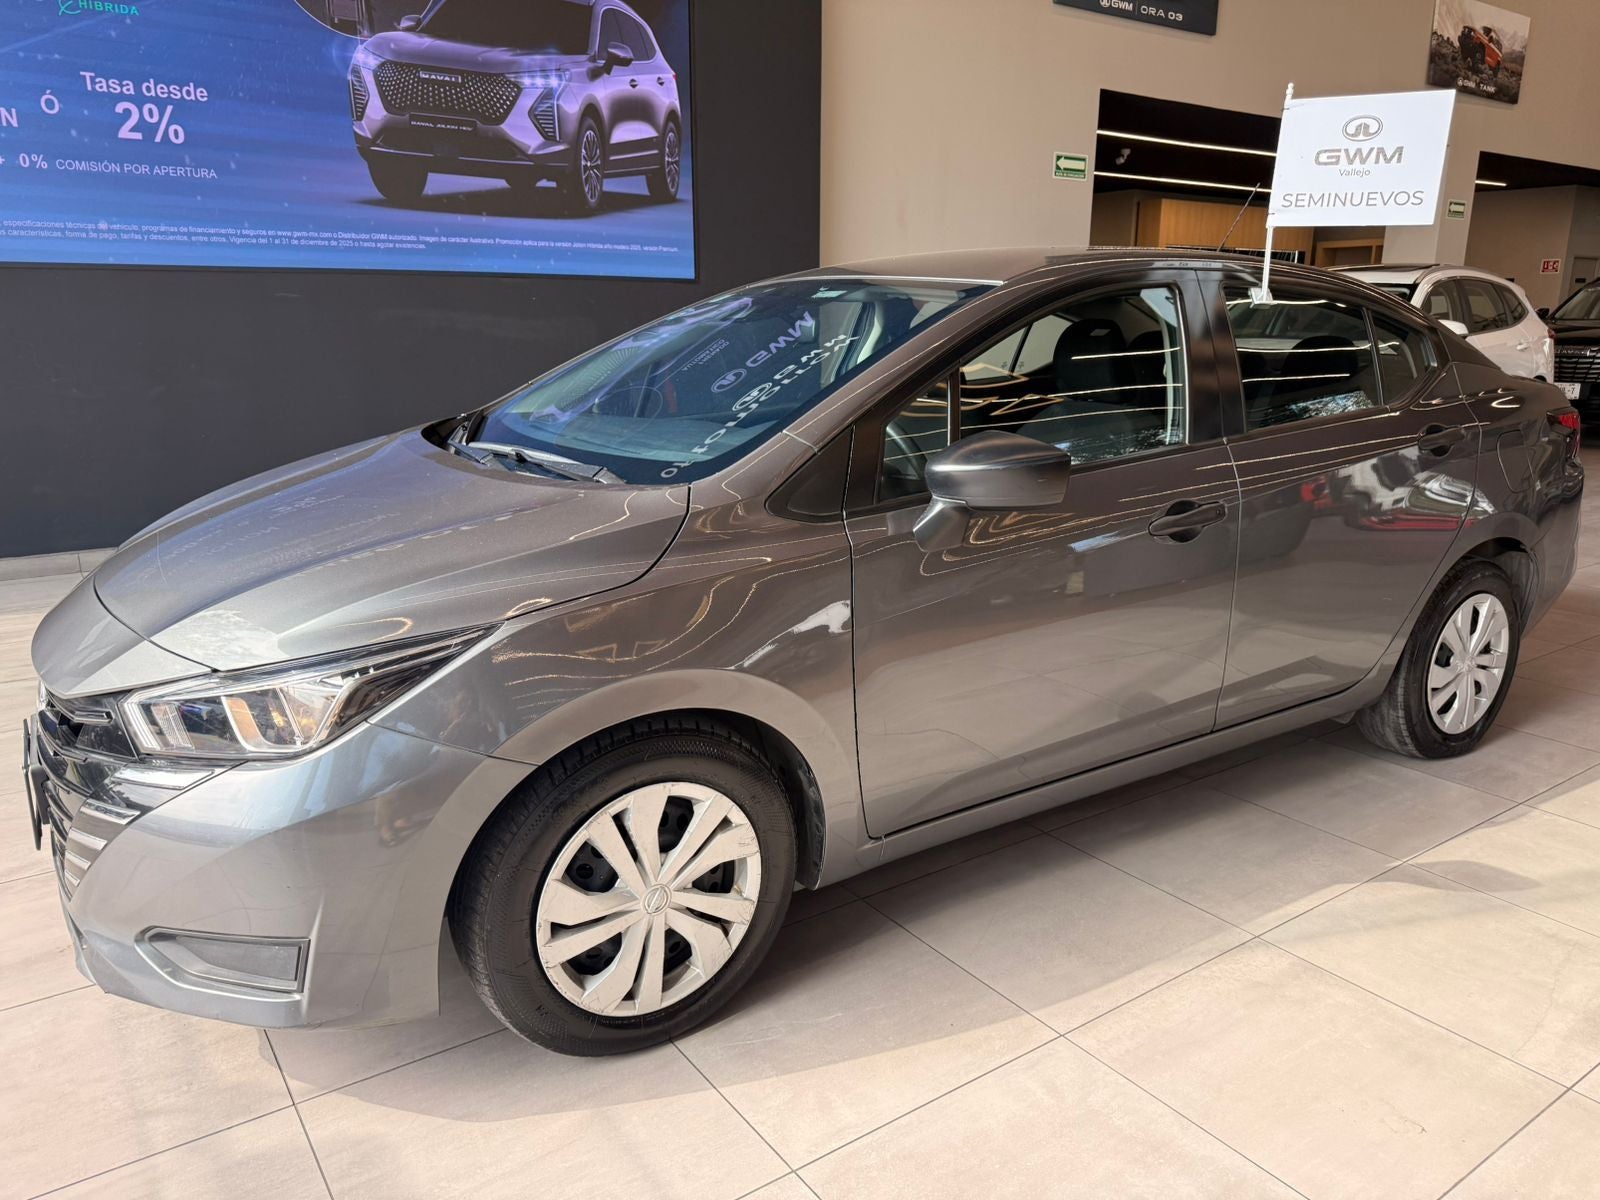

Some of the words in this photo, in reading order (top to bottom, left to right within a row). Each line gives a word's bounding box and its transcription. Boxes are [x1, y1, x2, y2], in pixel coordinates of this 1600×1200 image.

[1111, 0, 1133, 11] GWM
[1140, 5, 1166, 18] ORA
[1168, 11, 1184, 21] 03
[80, 71, 135, 95] Tasa
[141, 78, 209, 102] desde
[1480, 84, 1496, 93] TANK
[40, 89, 60, 114] Ó
[114, 101, 185, 145] 2%
[19, 153, 48, 169] 0%
[56, 159, 121, 174] COMISIÓN
[124, 163, 151, 175] POR
[153, 165, 218, 179] APERTURA
[1314, 145, 1404, 166] GWM
[1338, 167, 1371, 178] Vallejo
[1281, 190, 1425, 208] SEMINUEVOS
